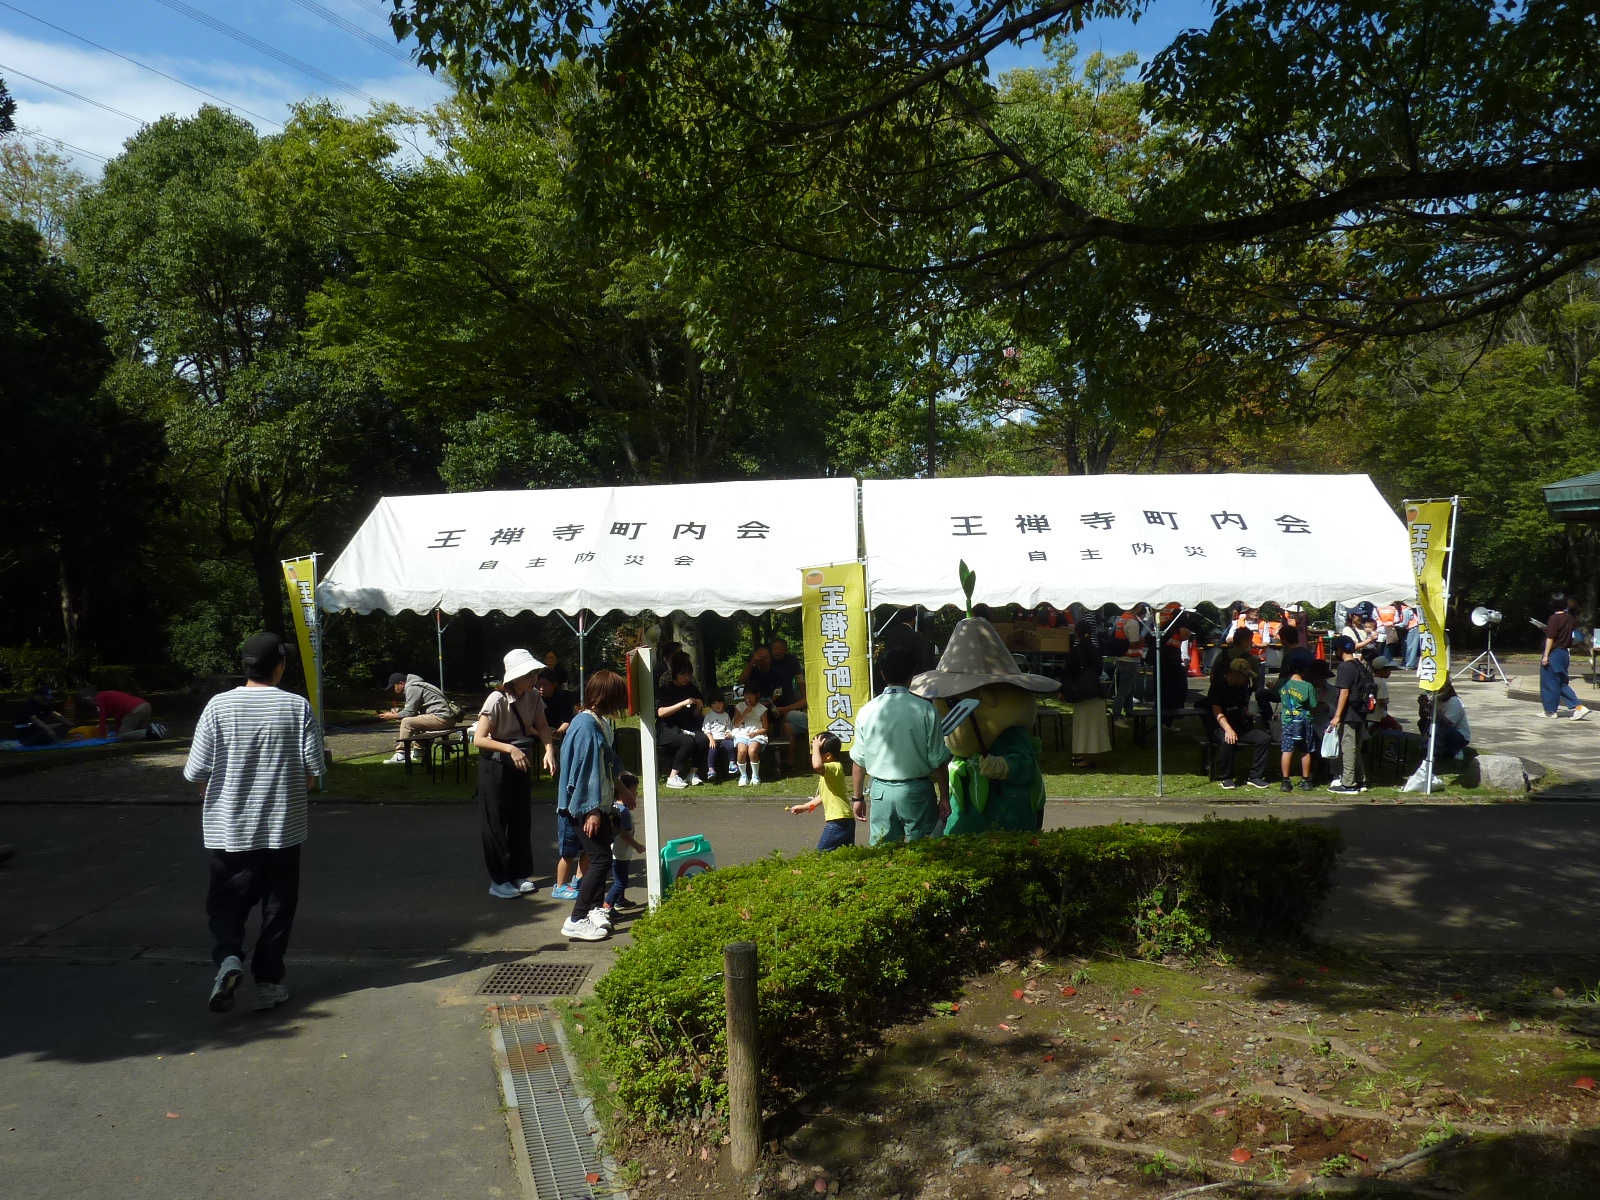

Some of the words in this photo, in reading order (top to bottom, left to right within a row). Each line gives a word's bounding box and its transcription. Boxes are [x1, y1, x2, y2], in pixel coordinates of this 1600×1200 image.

[427, 520, 771, 549] 王禅寺町内会
[950, 510, 1312, 536] 王禅寺町内会
[478, 551, 695, 570] 自主防災会
[1028, 542, 1257, 562] 自主防災会
